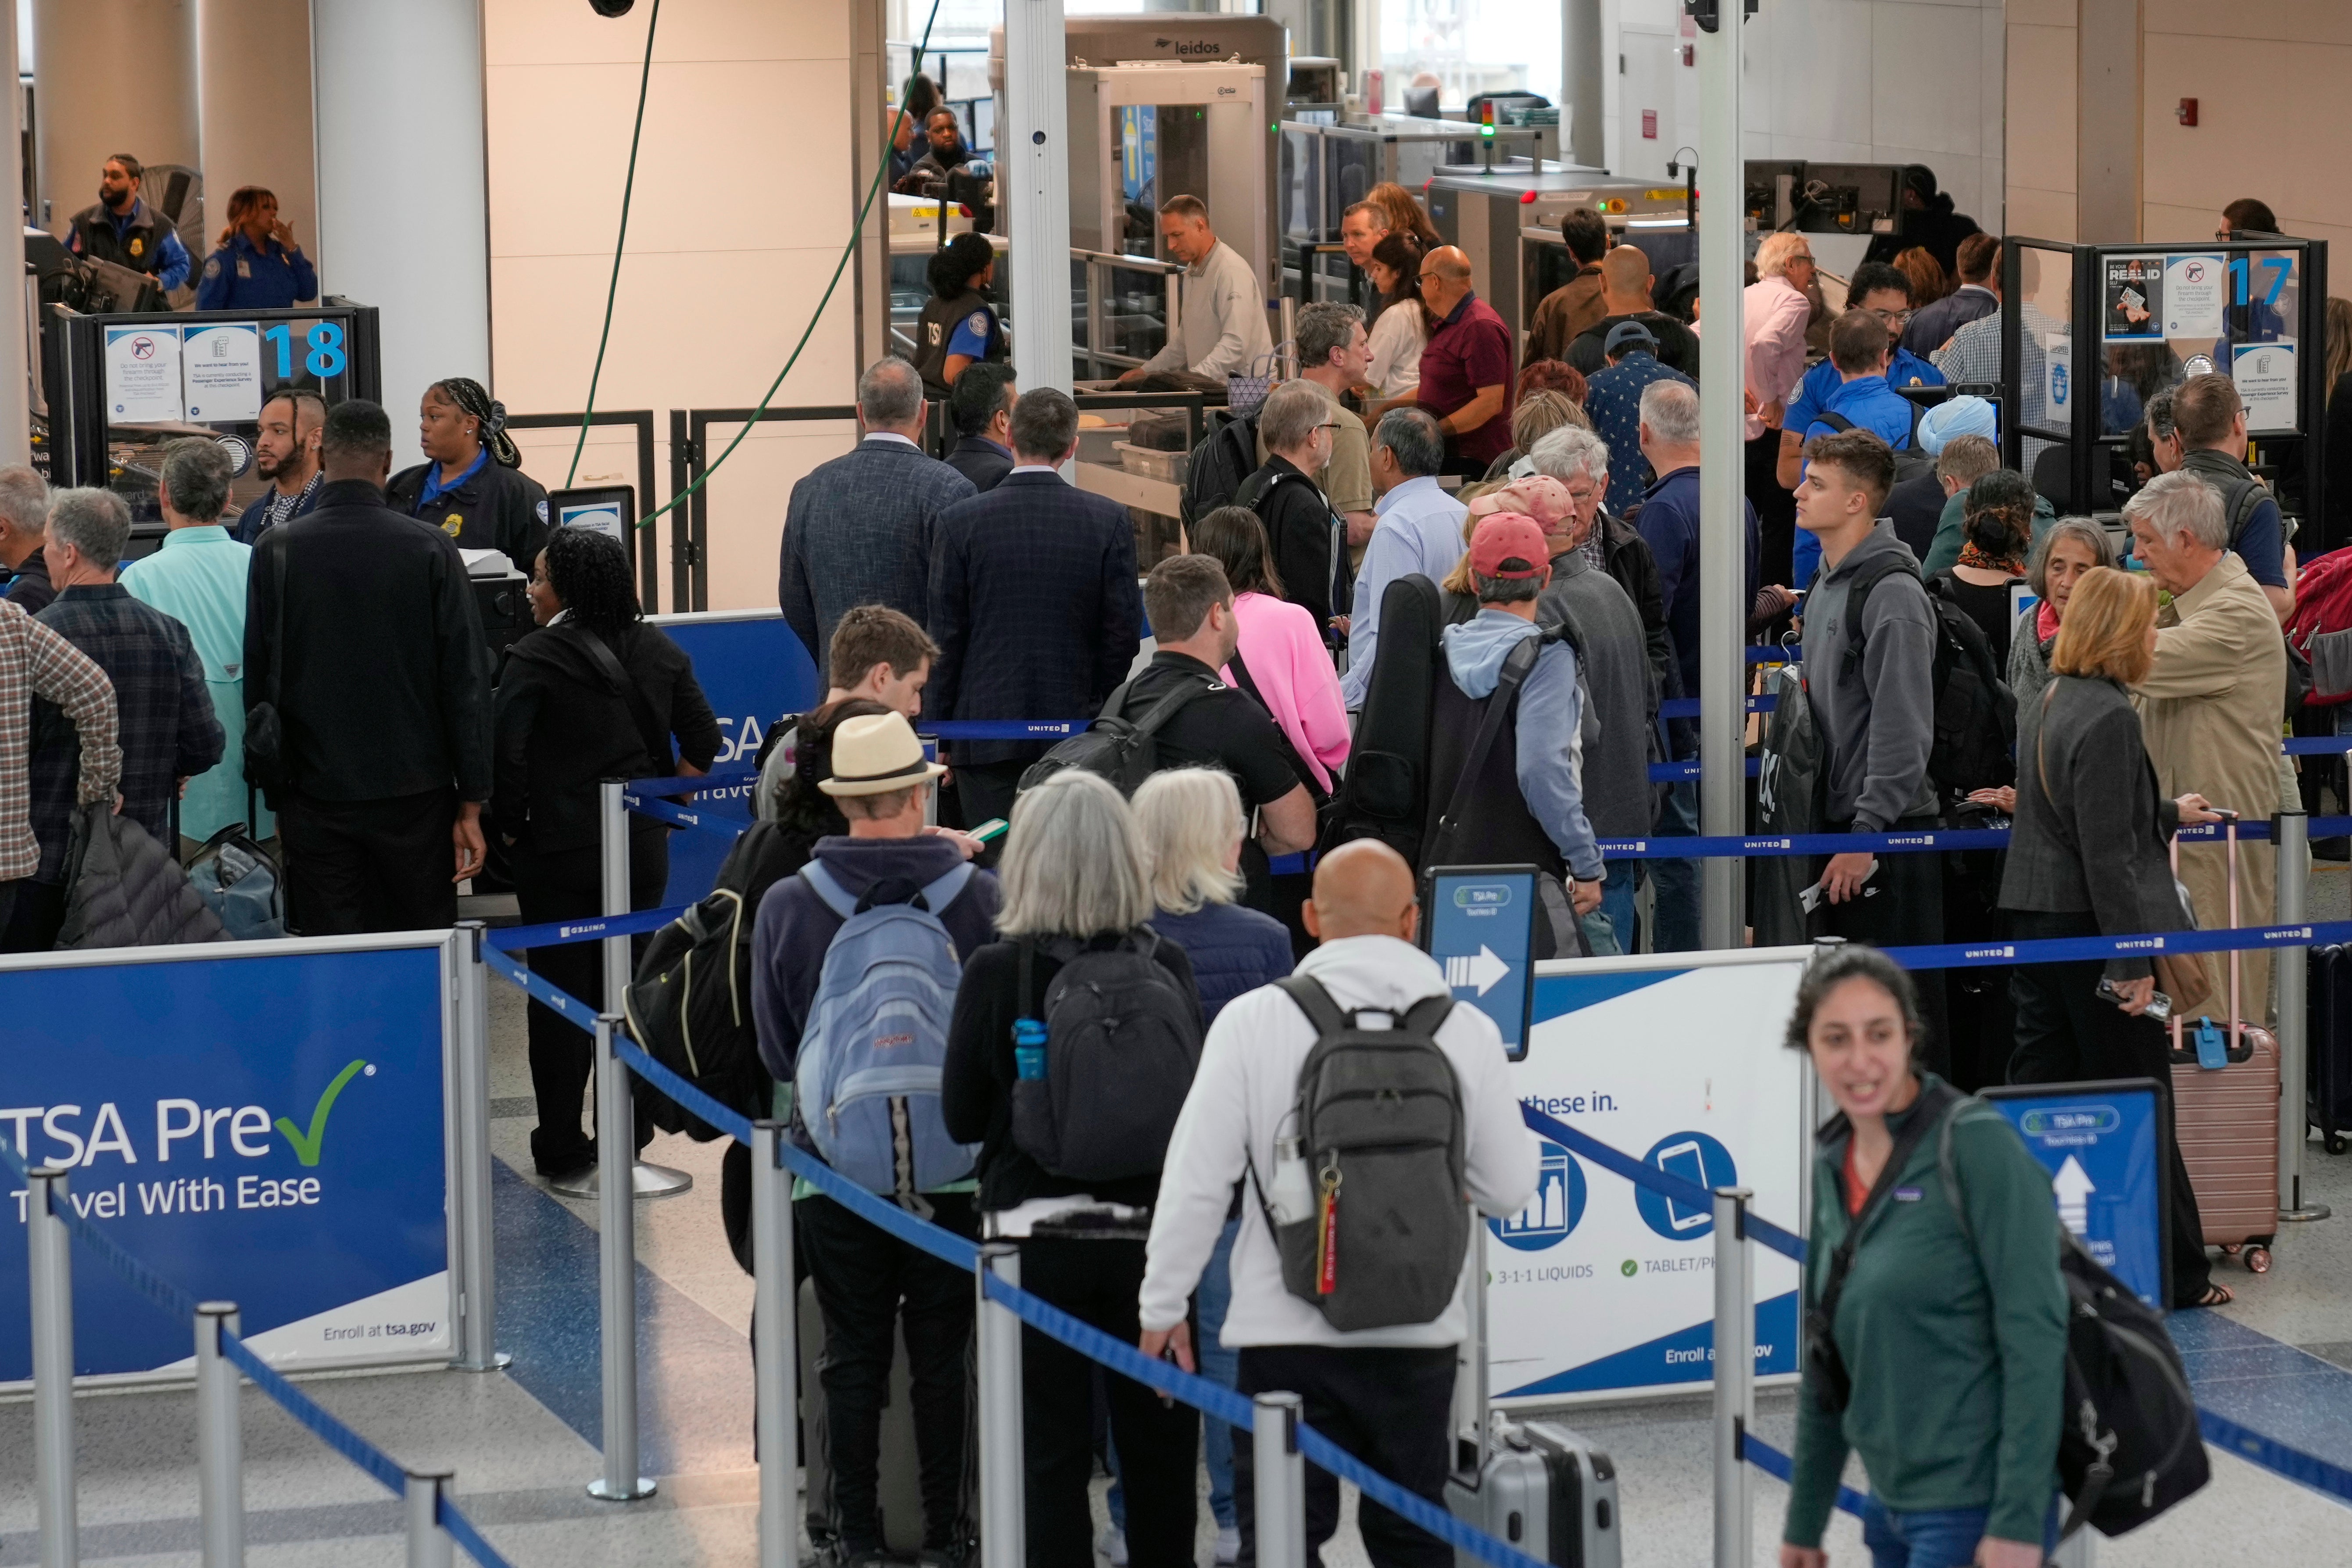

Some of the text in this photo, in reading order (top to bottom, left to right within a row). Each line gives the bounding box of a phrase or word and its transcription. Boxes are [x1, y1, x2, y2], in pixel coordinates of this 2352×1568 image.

[1175, 40, 1220, 54] leidos
[2109, 269, 2160, 280] REAL ID
[2228, 258, 2293, 305] 17
[265, 322, 346, 377] 18
[2050, 344, 2069, 354] EMPLOYEES
[713, 716, 764, 763] SA
[571, 923, 606, 934] UNITED
[2264, 930, 2301, 939] UNITED
[1965, 949, 2003, 958] UNITED
[2115, 940, 2153, 949] UNITED
[1524, 1090, 1618, 1114] these in.
[0, 1098, 271, 1169] TSA Pre
[10, 1175, 321, 1223] Tvel With Ease
[1644, 1256, 1716, 1273] TABLET/PH
[1499, 1264, 1593, 1284] 3-1-1 LIQUIDS
[324, 1321, 436, 1341] Enroll at tsa.gov
[1665, 1346, 1716, 1364] Enroll a
